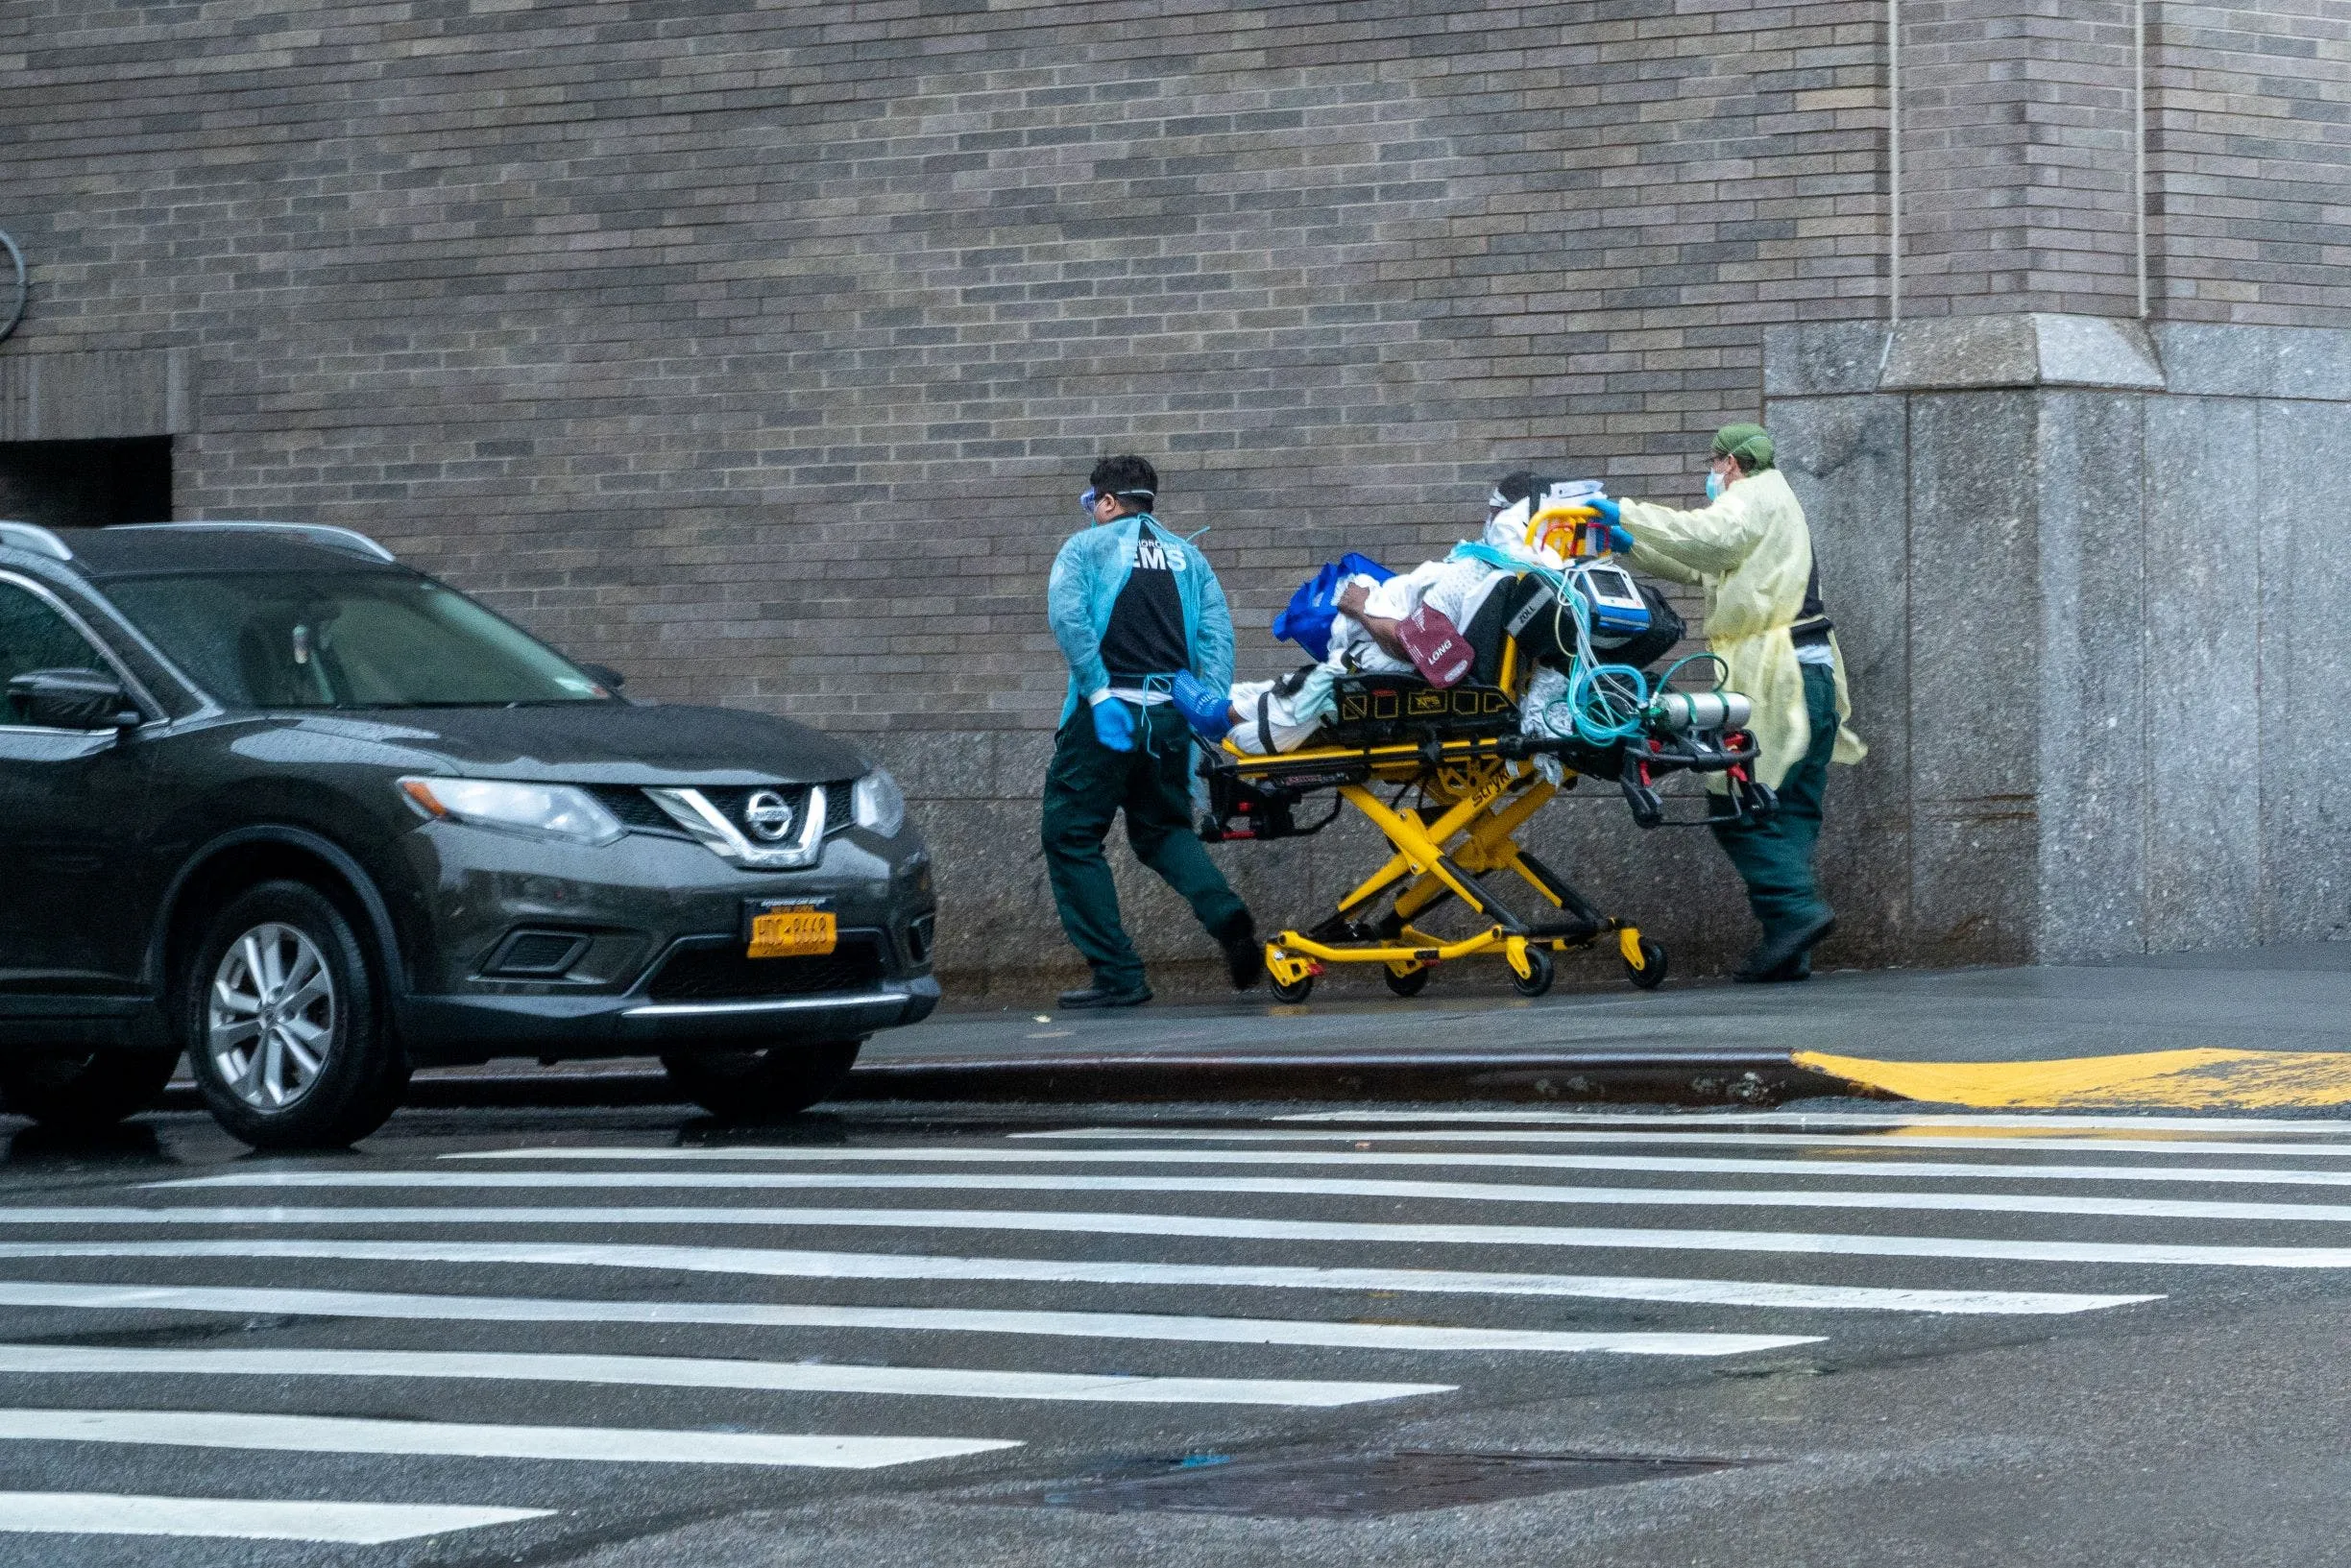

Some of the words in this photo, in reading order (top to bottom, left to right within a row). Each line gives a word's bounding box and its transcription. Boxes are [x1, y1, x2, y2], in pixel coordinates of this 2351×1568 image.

[1518, 605, 1537, 624] ZOLL
[1427, 639, 1452, 665] LONG
[1471, 769, 1513, 808] stryk
